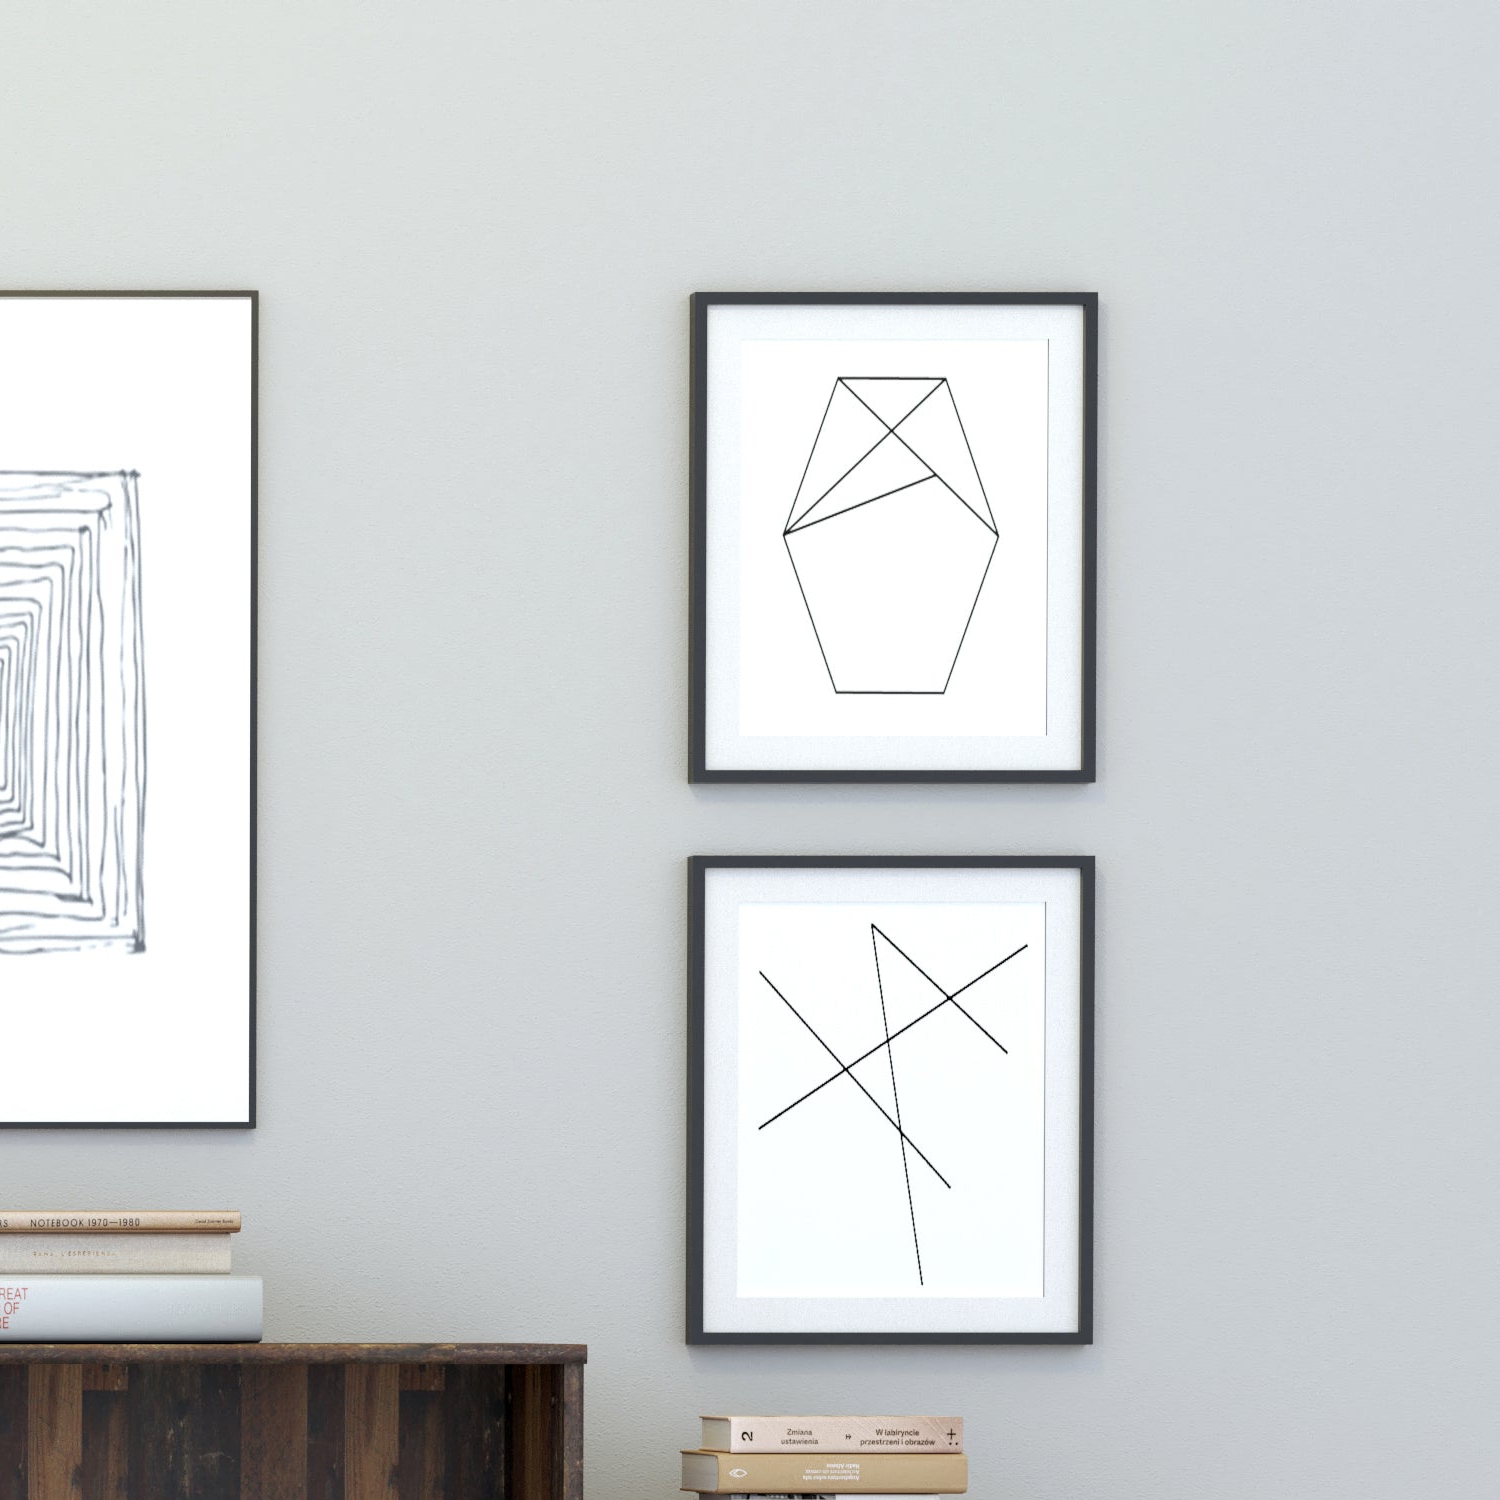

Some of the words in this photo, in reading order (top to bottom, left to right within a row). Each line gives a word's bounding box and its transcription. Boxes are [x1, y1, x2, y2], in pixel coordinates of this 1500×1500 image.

[30, 1218, 84, 1227] NOTEBOOK
[4, 1302, 20, 1315] OF
[741, 1431, 753, 1442] 2
[786, 1428, 813, 1436] Zmiana
[884, 1428, 920, 1437] labiryncie
[904, 1438, 936, 1446] obrazów
